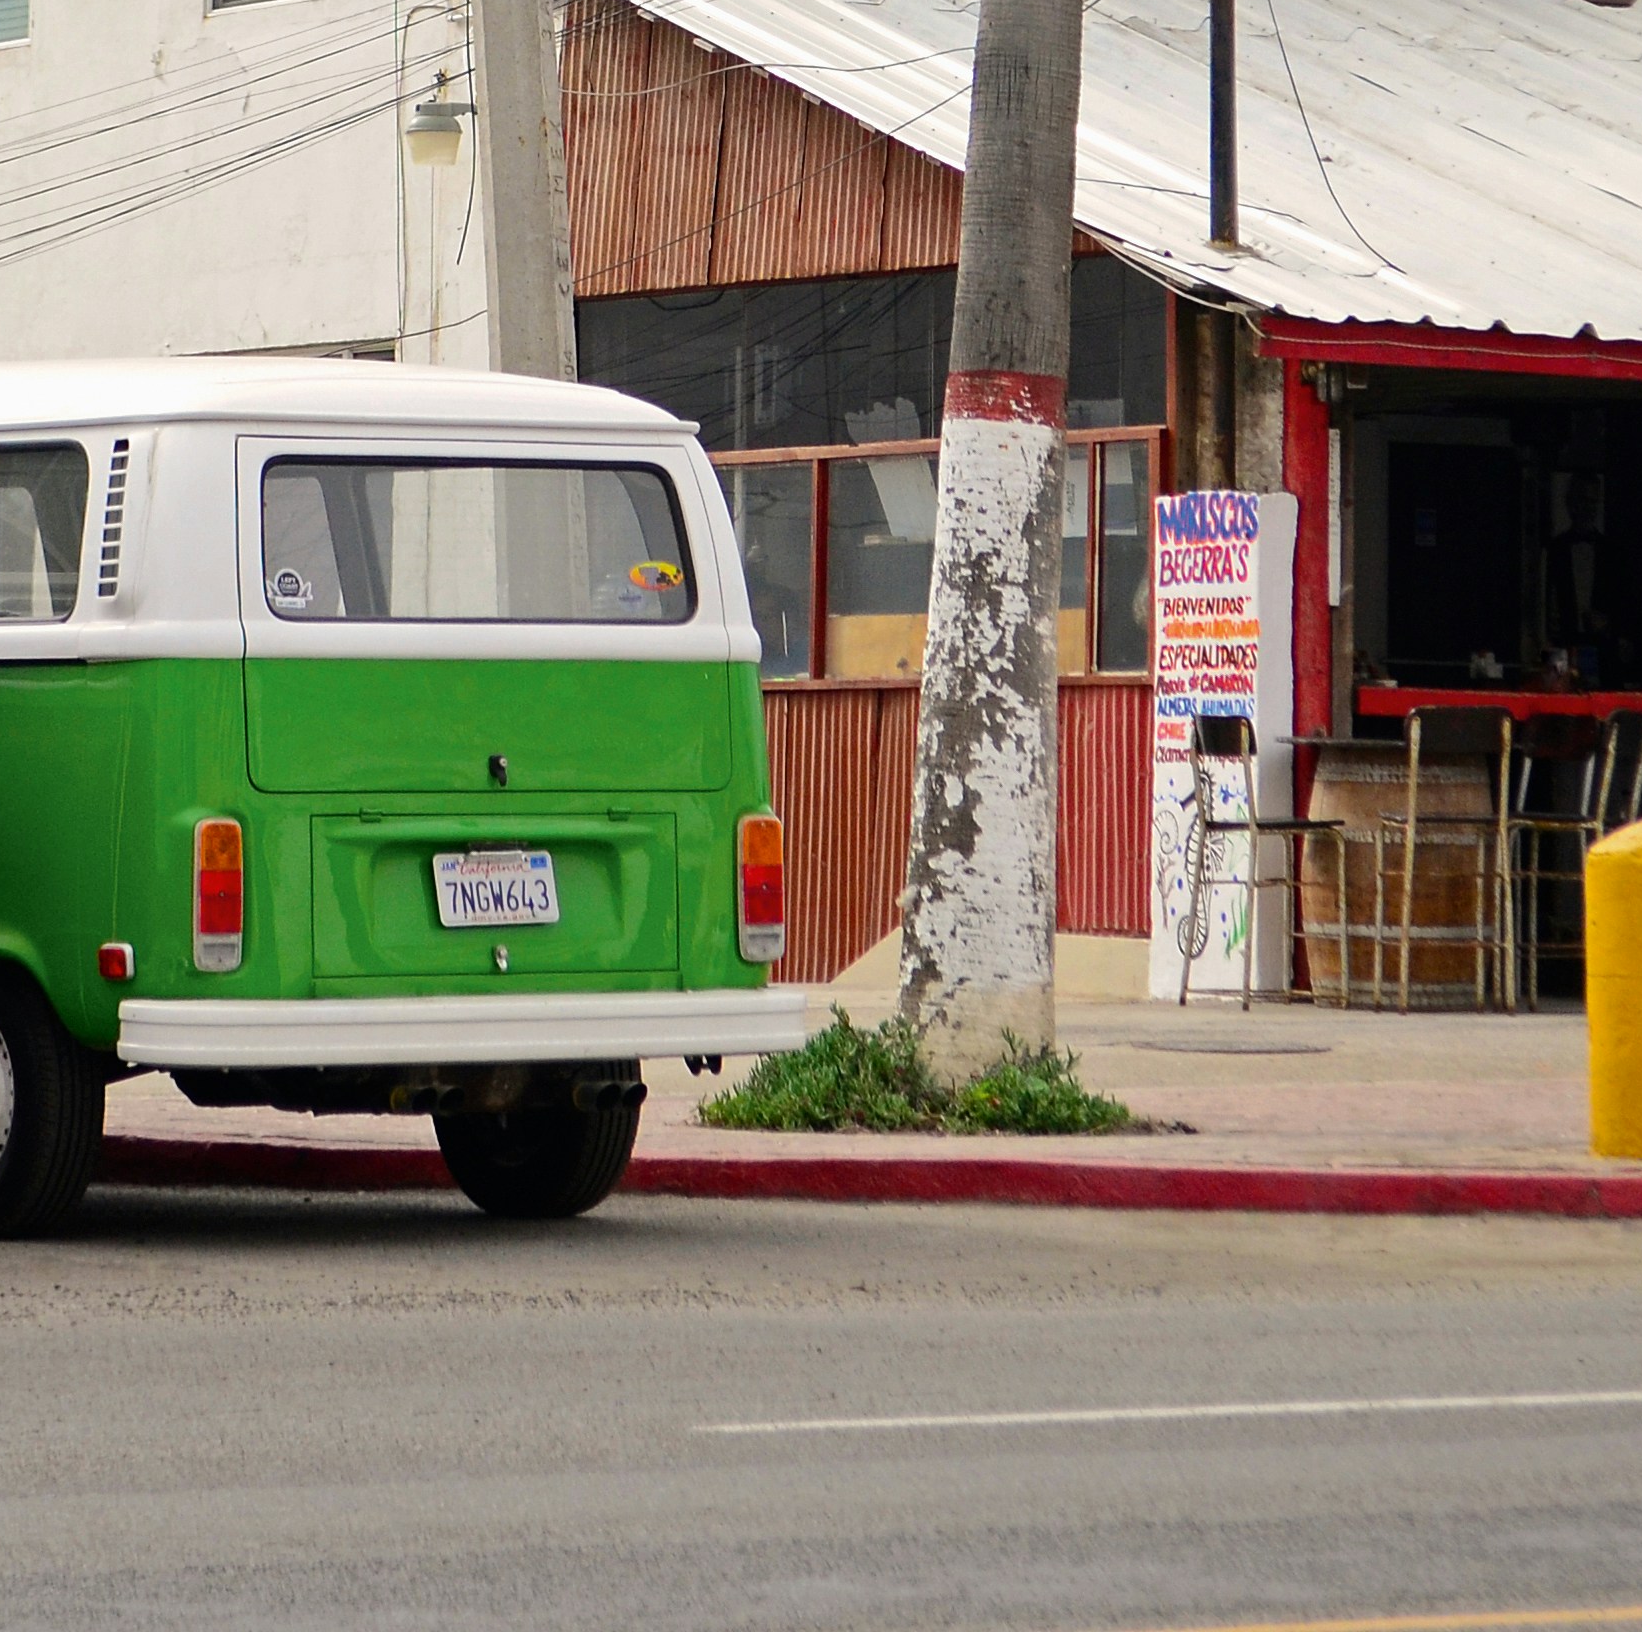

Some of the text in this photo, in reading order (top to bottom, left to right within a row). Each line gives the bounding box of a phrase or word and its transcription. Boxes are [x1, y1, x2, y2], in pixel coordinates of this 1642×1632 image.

[1158, 492, 1259, 544] MARISCOS
[1160, 544, 1249, 586] BECERRA'S
[1160, 644, 1257, 670] ESPECIALIDADES
[458, 861, 530, 879] California
[445, 879, 549, 914] 7NGW643
